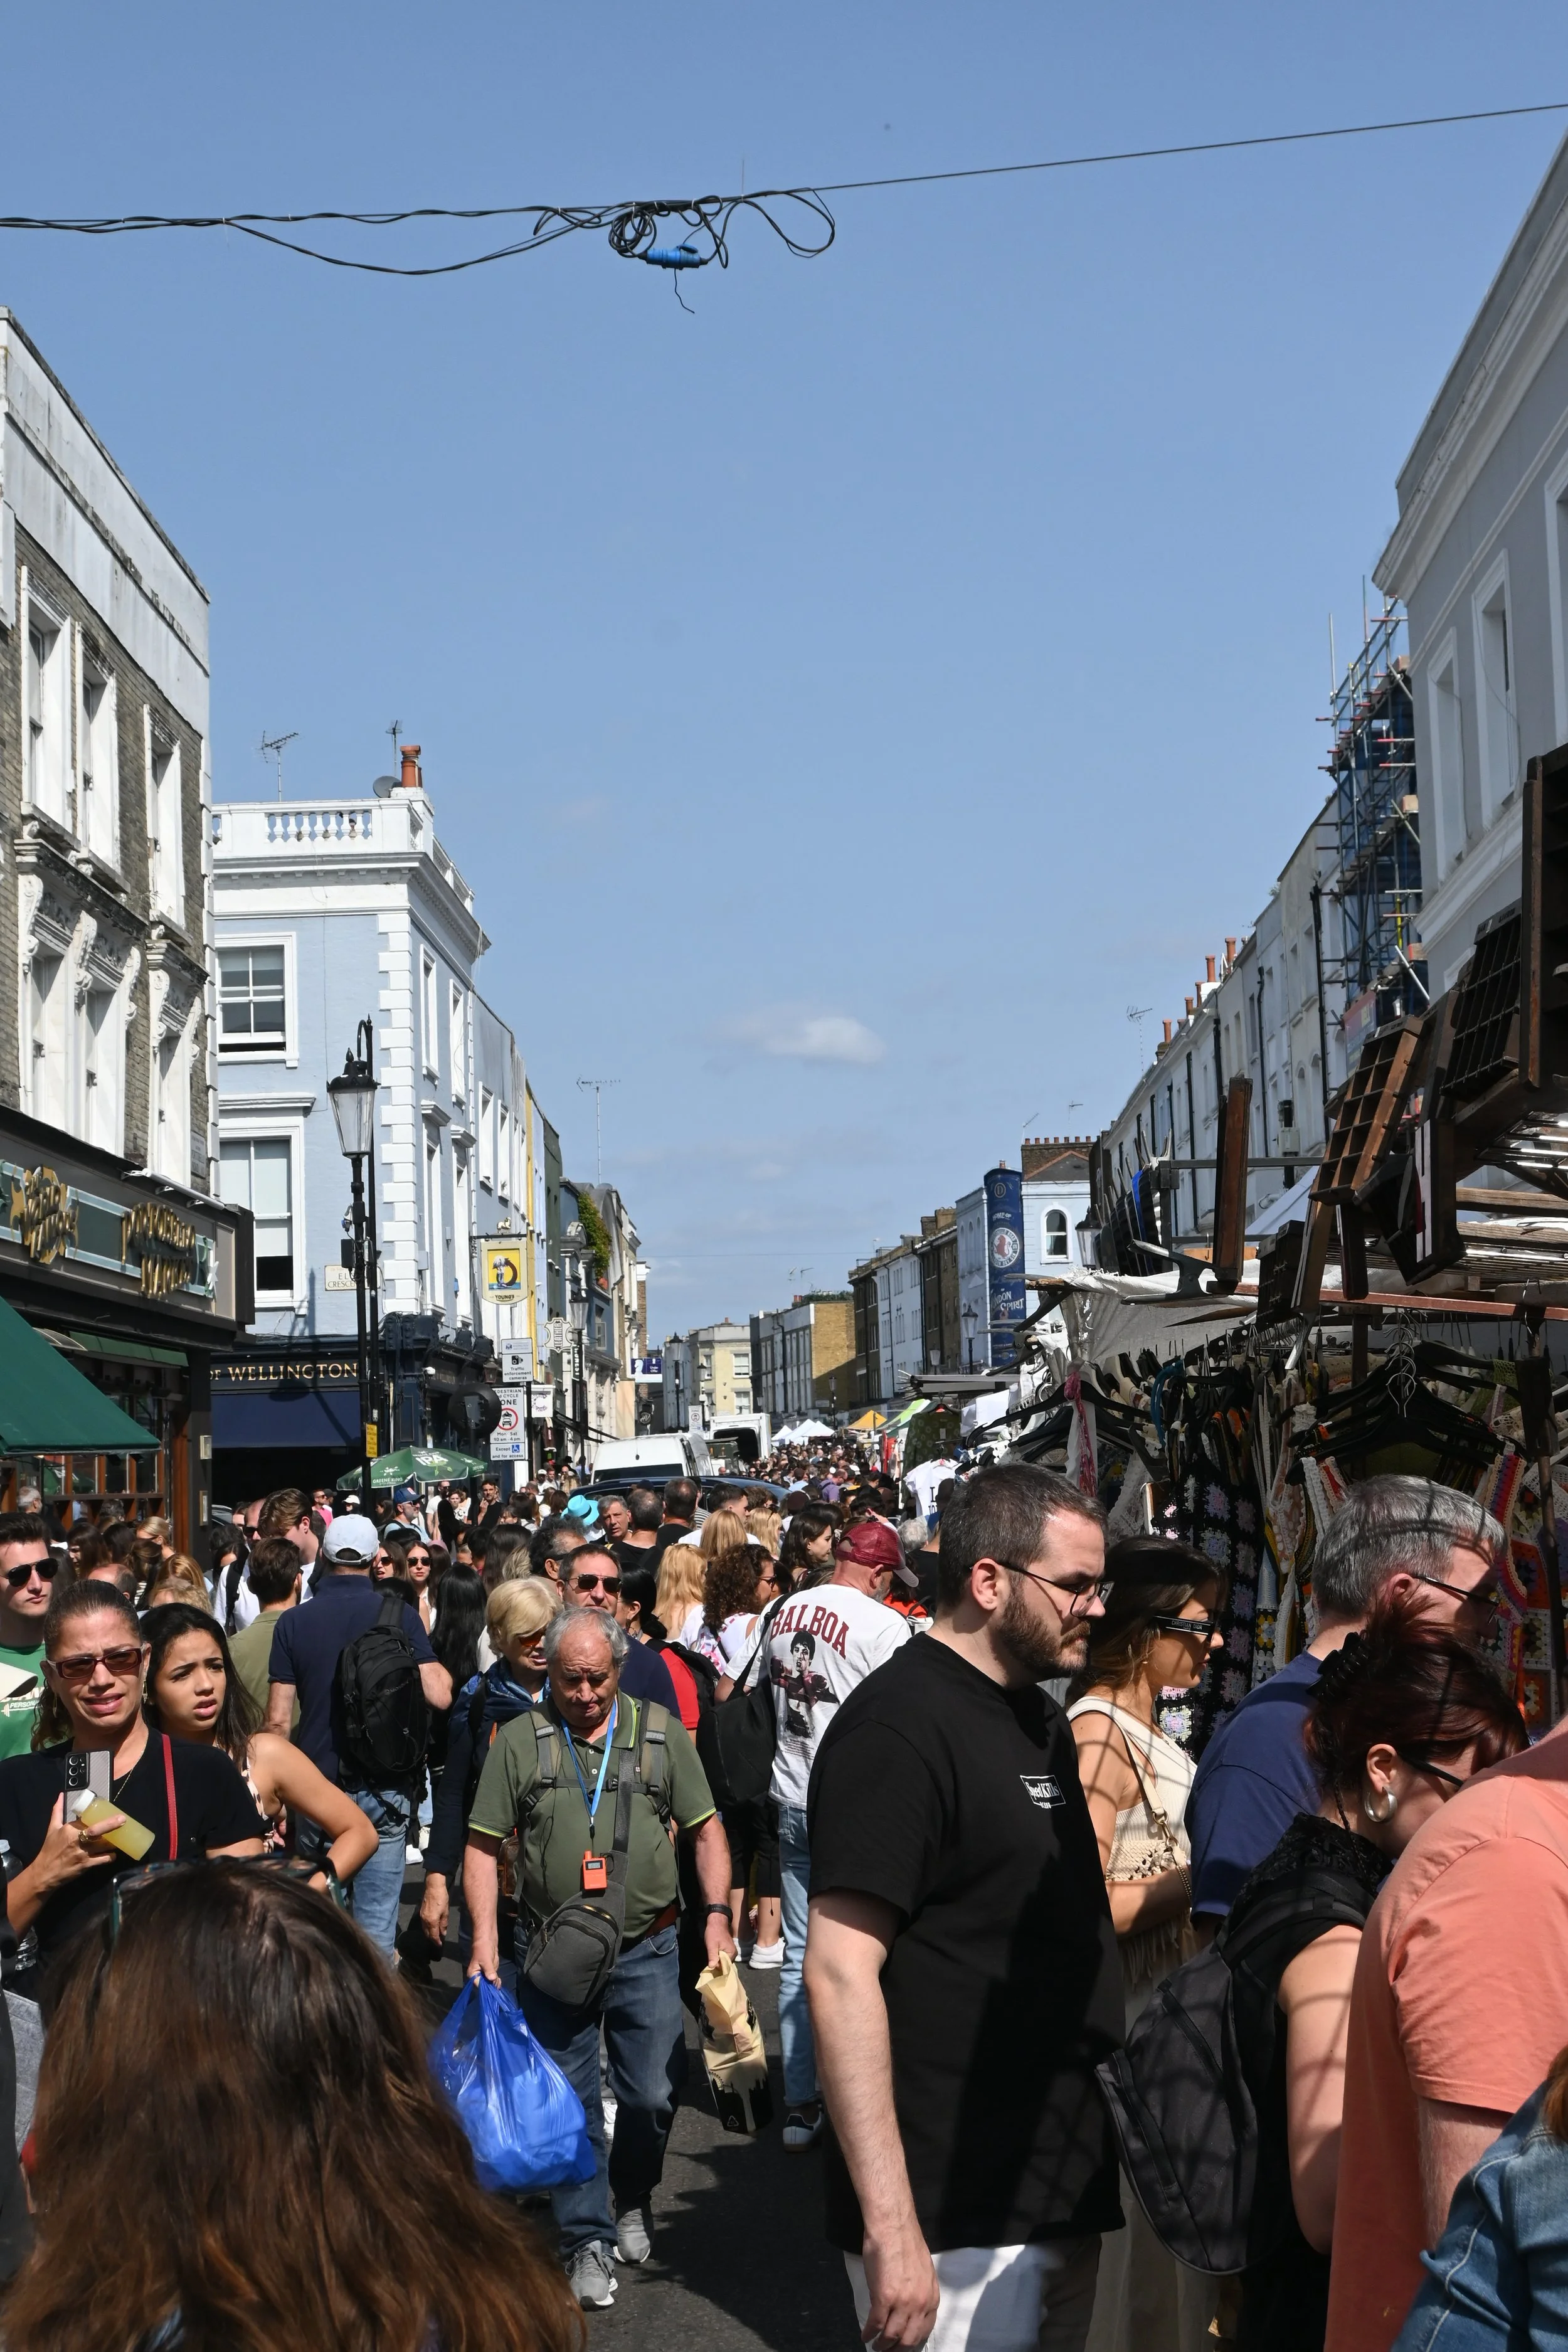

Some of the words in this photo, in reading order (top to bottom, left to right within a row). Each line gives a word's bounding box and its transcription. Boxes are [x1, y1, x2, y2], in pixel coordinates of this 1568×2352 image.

[1000, 1298, 1024, 1311] SPIRIT
[554, 1323, 563, 1347] LEATHER
[228, 1363, 358, 1382] WELLINGTON
[416, 1455, 448, 1465] IPA
[770, 1604, 850, 1660] BALBOA
[1172, 1620, 1191, 1628] CHRISTIAN
